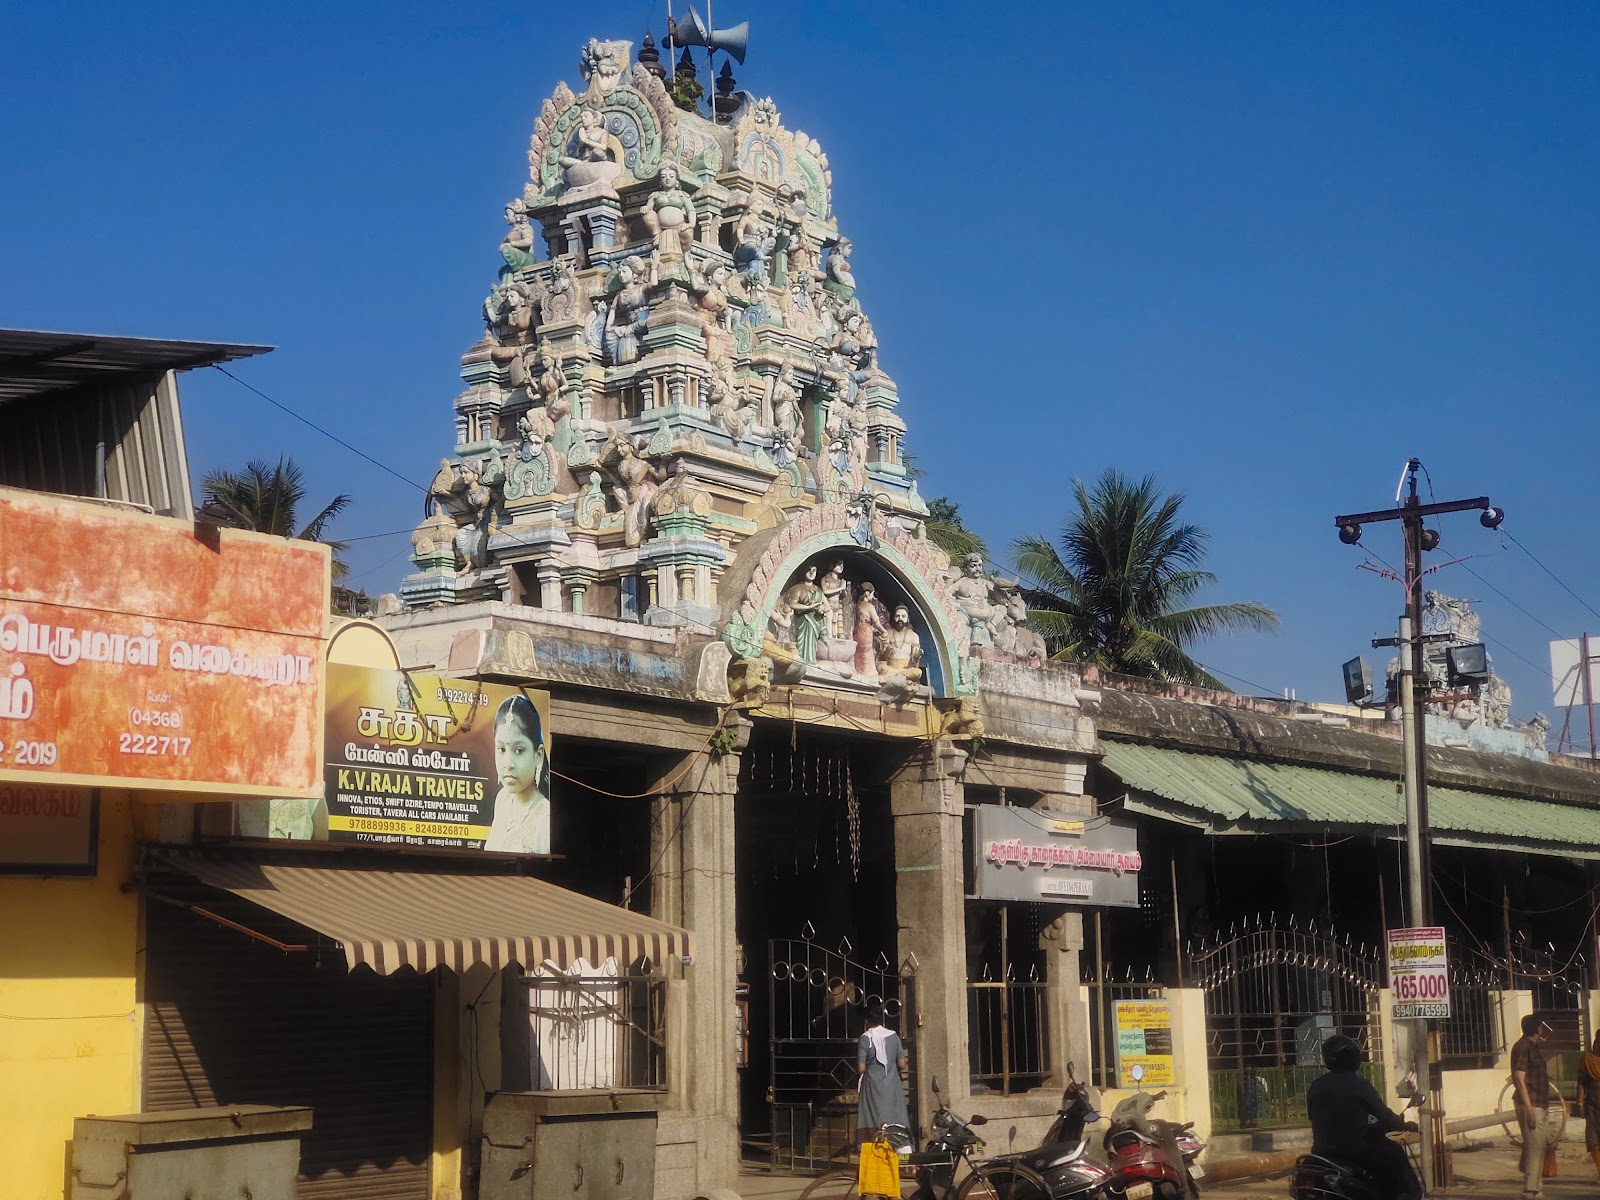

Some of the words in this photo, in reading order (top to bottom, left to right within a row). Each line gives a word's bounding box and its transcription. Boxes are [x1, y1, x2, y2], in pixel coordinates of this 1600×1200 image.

[0, 613, 161, 666] பெருமாள்
[437, 687, 488, 707] 99221419
[128, 706, 184, 729] (04368)
[357, 706, 452, 746] சுதா
[119, 732, 192, 756] 222717
[344, 742, 409, 766] பேன்ஸி
[411, 748, 471, 772] ஸ்டோர்
[338, 769, 412, 795] K.V.RAJA
[416, 776, 484, 801] TRAVELS
[337, 793, 363, 805] INNOVA,
[364, 796, 384, 806] ETIOS,
[385, 797, 404, 807] SWIFT
[444, 802, 479, 814] TRAVELLER,
[350, 805, 382, 817] TORISTER,
[383, 808, 407, 818] TAVERA
[407, 810, 420, 819] ALL
[420, 811, 436, 820] CARS
[437, 812, 469, 822] AVAILABLE
[349, 818, 406, 832] 9788899936
[415, 823, 469, 836] 8248826870
[990, 839, 1030, 867] அருள்மிகு
[1031, 844, 1075, 869] காரைக்கால்
[1076, 846, 1115, 867] அம்மையார்
[1116, 850, 1142, 874] ஆலயம்
[1395, 1004, 1448, 1017] 9940776599
